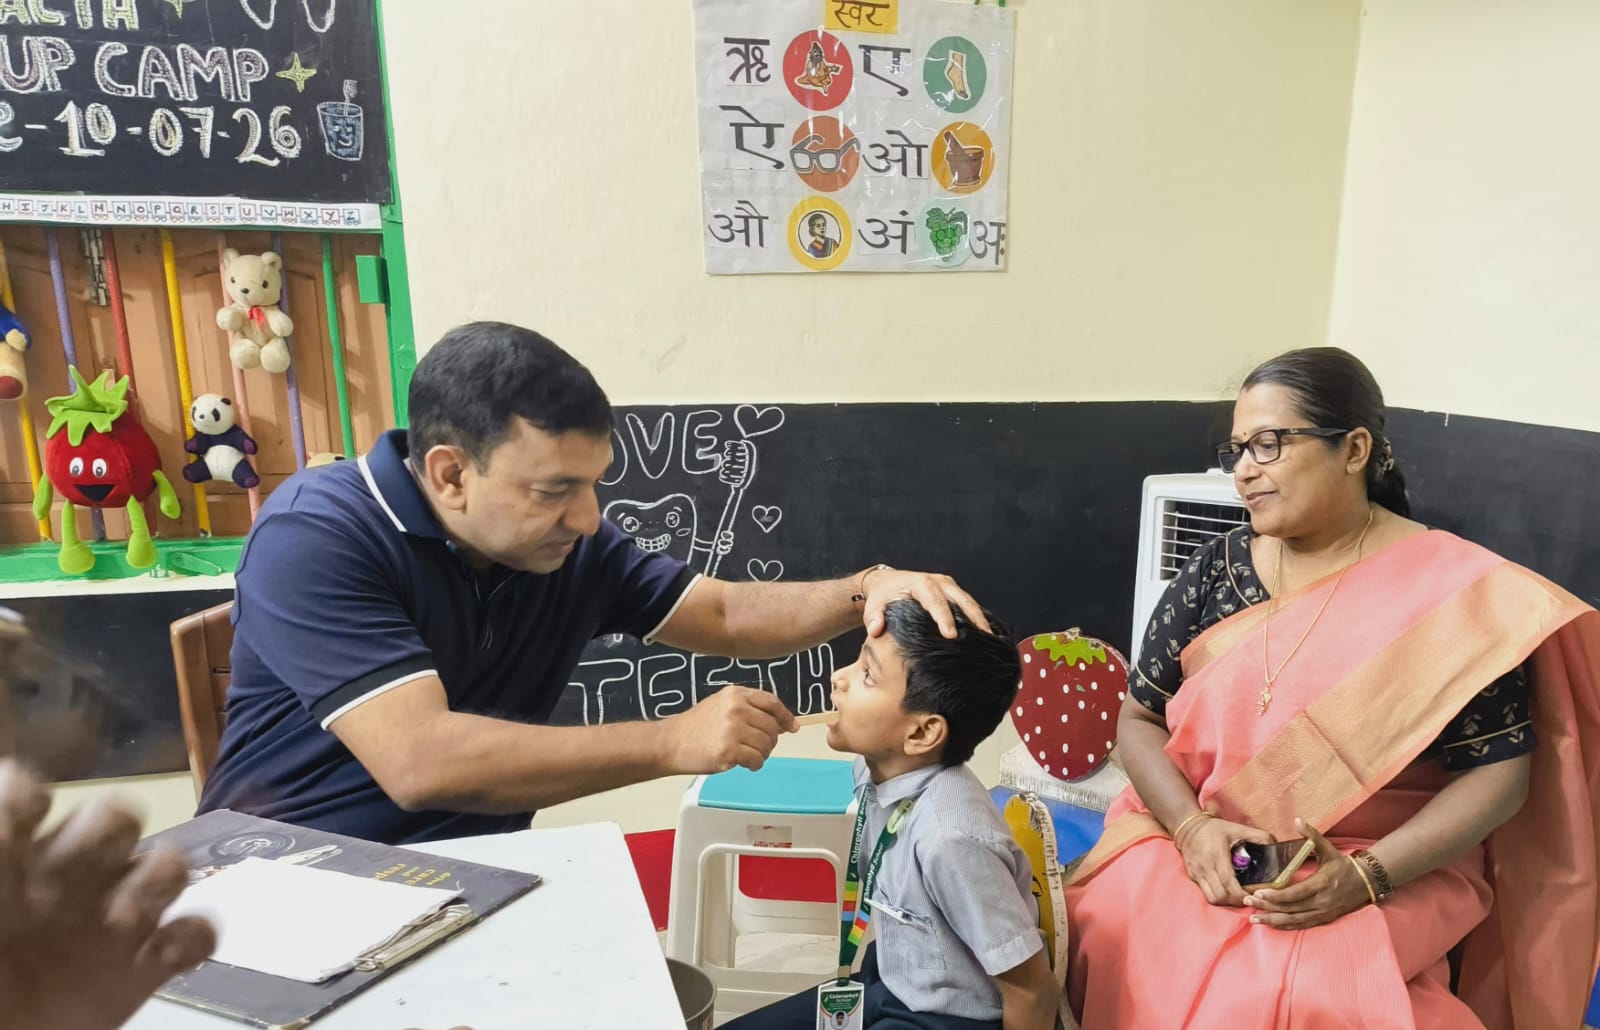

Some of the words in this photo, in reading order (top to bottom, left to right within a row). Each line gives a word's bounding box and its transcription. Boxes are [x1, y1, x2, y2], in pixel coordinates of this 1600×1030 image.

[832, 0, 890, 29] स्वर
[94, 42, 269, 101] CAMP
[723, 37, 771, 84] ऋ
[858, 44, 911, 97] ए
[718, 104, 785, 170] ऐ
[862, 130, 929, 178] ओ
[2, 202, 11, 210] H
[21, 203, 30, 211] I
[41, 204, 49, 212] J
[61, 204, 68, 212] K
[78, 205, 85, 213] L
[116, 204, 126, 213] N
[154, 205, 161, 214] P
[173, 206, 182, 214] Q
[190, 206, 199, 215] R
[210, 206, 217, 214] S
[242, 207, 251, 216] U
[325, 211, 335, 220] Y
[346, 211, 355, 220] Z
[707, 200, 769, 248] औ
[858, 210, 915, 254] अं
[404, 868, 437, 887] care
